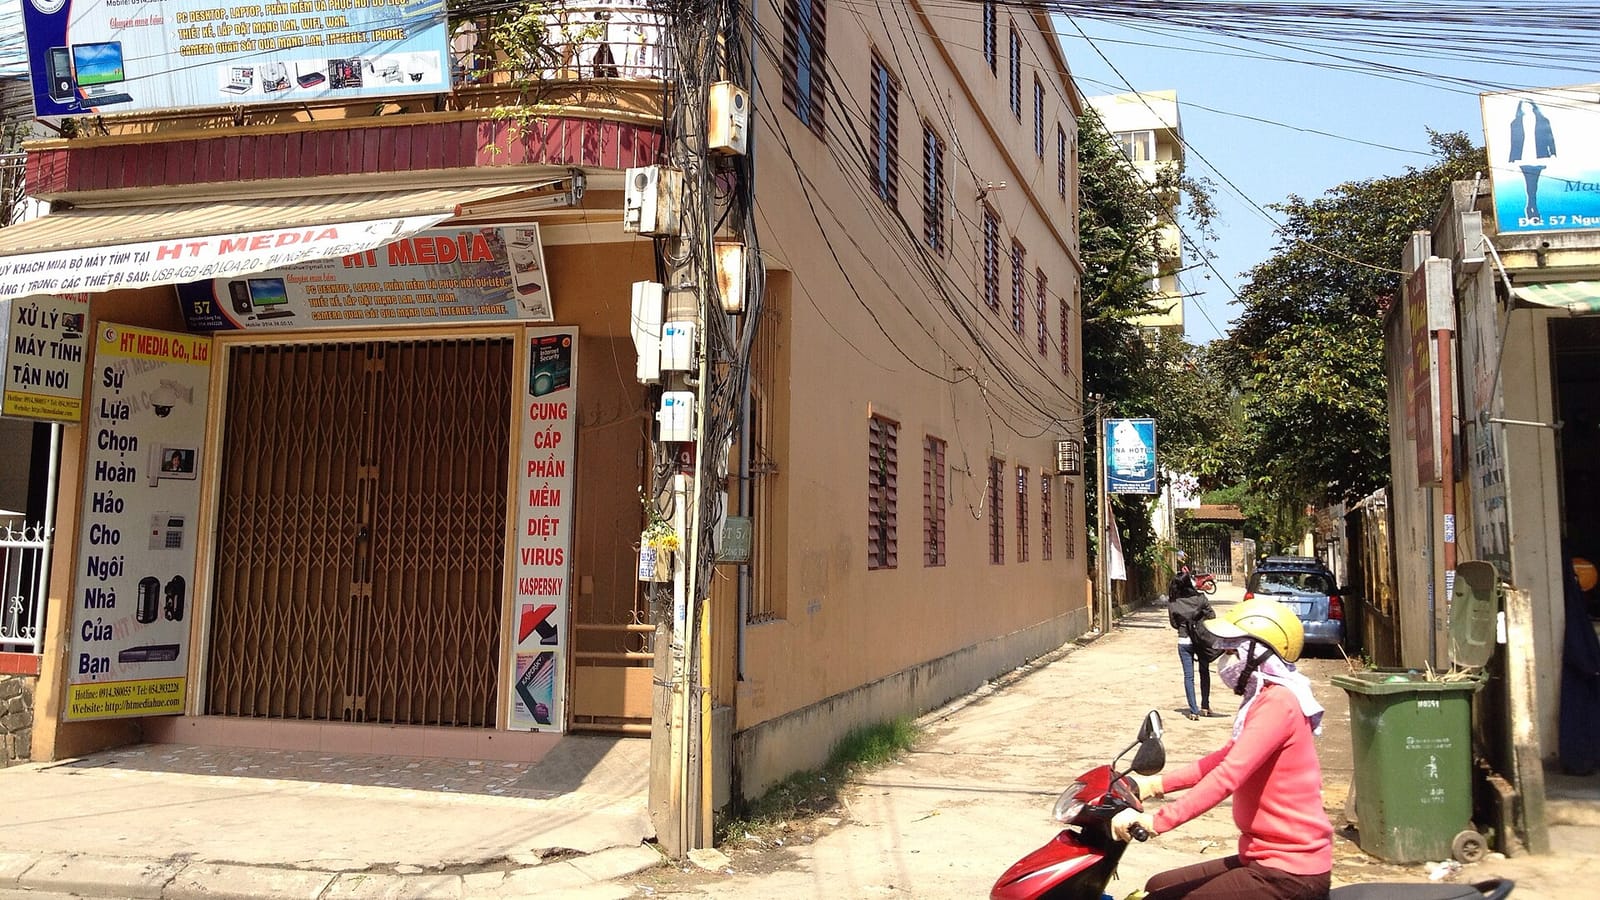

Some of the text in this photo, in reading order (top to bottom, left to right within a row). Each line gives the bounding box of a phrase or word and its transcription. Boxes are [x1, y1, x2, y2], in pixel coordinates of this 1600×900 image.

[176, 12, 188, 24] PC
[180, 43, 214, 56] CAMERA
[216, 42, 238, 54] QUAN
[258, 38, 276, 50] QUA
[1518, 216, 1544, 227] ĐC:
[1550, 215, 1566, 226] 57
[12, 259, 46, 275] KHÁCH
[46, 259, 66, 270] MUA
[84, 252, 107, 268] MÁY
[108, 250, 132, 264] TÍNH
[134, 250, 150, 266] TẠI
[156, 241, 209, 261] HT
[218, 227, 338, 255] MEDIA
[388, 233, 495, 267] MEDIA
[28, 278, 60, 292] TRONG
[61, 274, 81, 290] CÁC
[126, 271, 150, 283] SAU:
[152, 266, 176, 282] USB
[174, 264, 200, 279] 4GB
[219, 261, 242, 276] LOA
[241, 258, 261, 271] 2.0
[306, 285, 316, 294] PC
[17, 302, 58, 330] XỬ LÝ
[194, 301, 210, 314] 57
[311, 311, 343, 320] CAMERA
[344, 310, 364, 320] QUAN
[380, 308, 396, 318] QUA
[15, 333, 82, 362] MÁY TÍNH
[120, 332, 209, 364] HT MEDIA Co., Ltd
[540, 348, 560, 356] Internet
[540, 354, 560, 362] Security
[13, 363, 69, 390] TẬN NƠI
[103, 366, 125, 394] Sự
[100, 398, 130, 425] Lựa
[530, 402, 568, 420] CUNG
[97, 428, 138, 457] Chọn
[534, 424, 562, 450] CẤP
[95, 460, 136, 483] Hoàn
[528, 452, 566, 478] PHẦN
[92, 490, 124, 514] Hảo
[529, 482, 562, 508] MỀM
[90, 524, 120, 546] Cho
[528, 514, 560, 542] DIỆT
[87, 556, 124, 582] Ngôi
[521, 548, 564, 566] VIRUS
[84, 587, 116, 610] Nhà
[518, 577, 563, 596] KASPERSKY
[82, 617, 113, 642] Của
[78, 653, 110, 680] Bạn
[75, 690, 98, 700] Hotline:
[136, 685, 148, 696] Tel:
[72, 703, 104, 714] Website:
